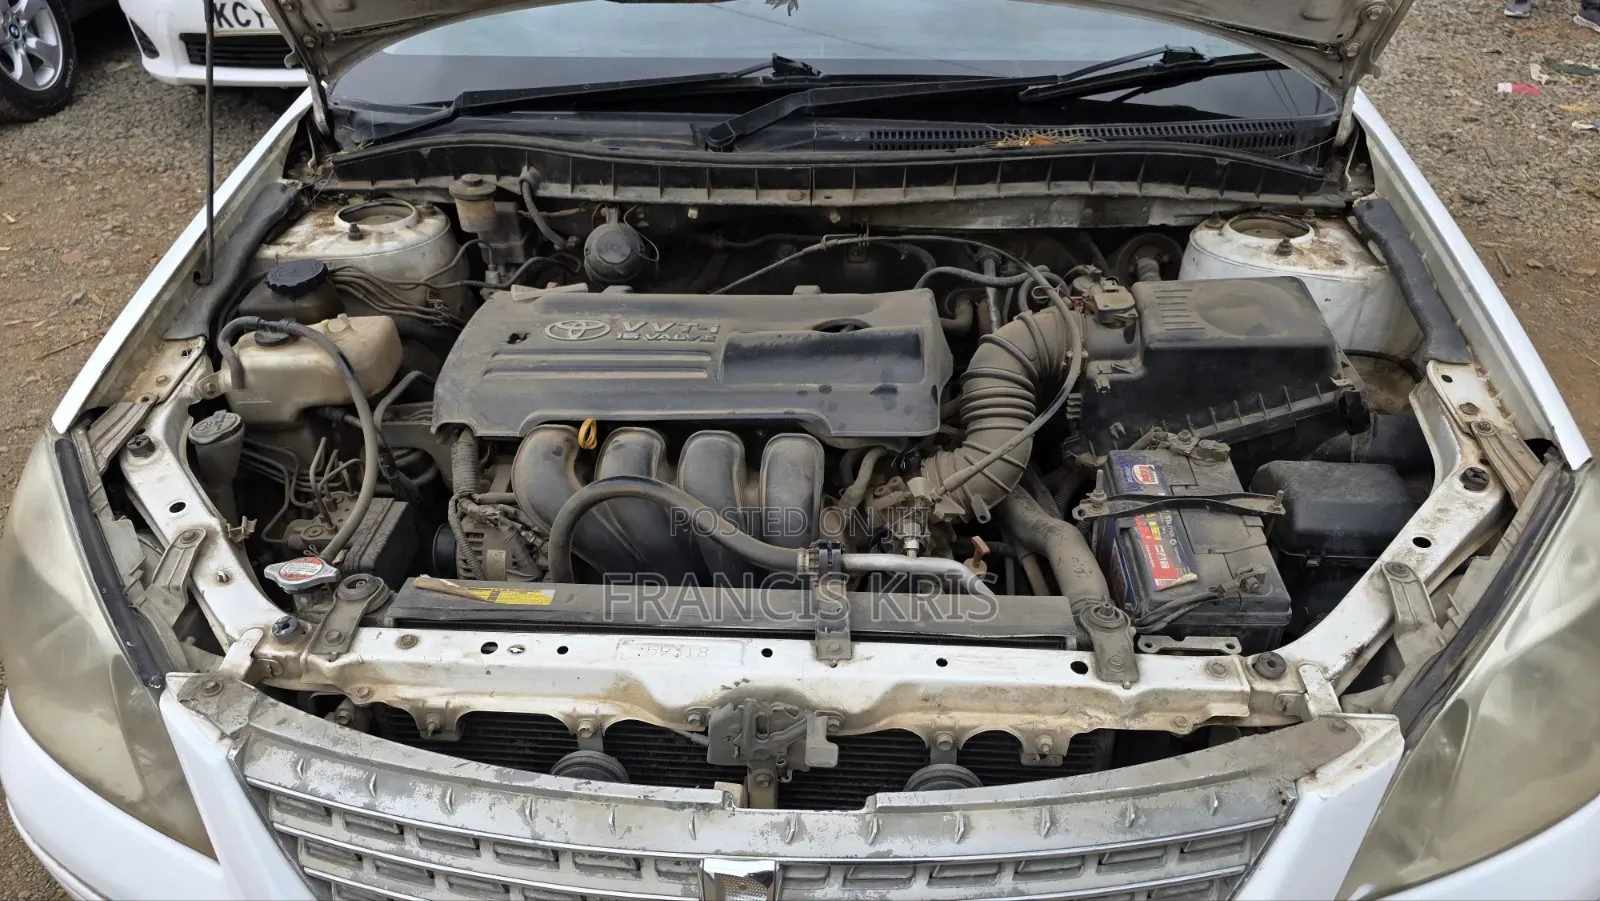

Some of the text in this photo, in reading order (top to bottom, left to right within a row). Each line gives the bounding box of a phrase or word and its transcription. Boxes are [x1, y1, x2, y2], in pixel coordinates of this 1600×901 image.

[213, 2, 265, 28] KCY
[616, 333, 716, 343] 16 VALVE
